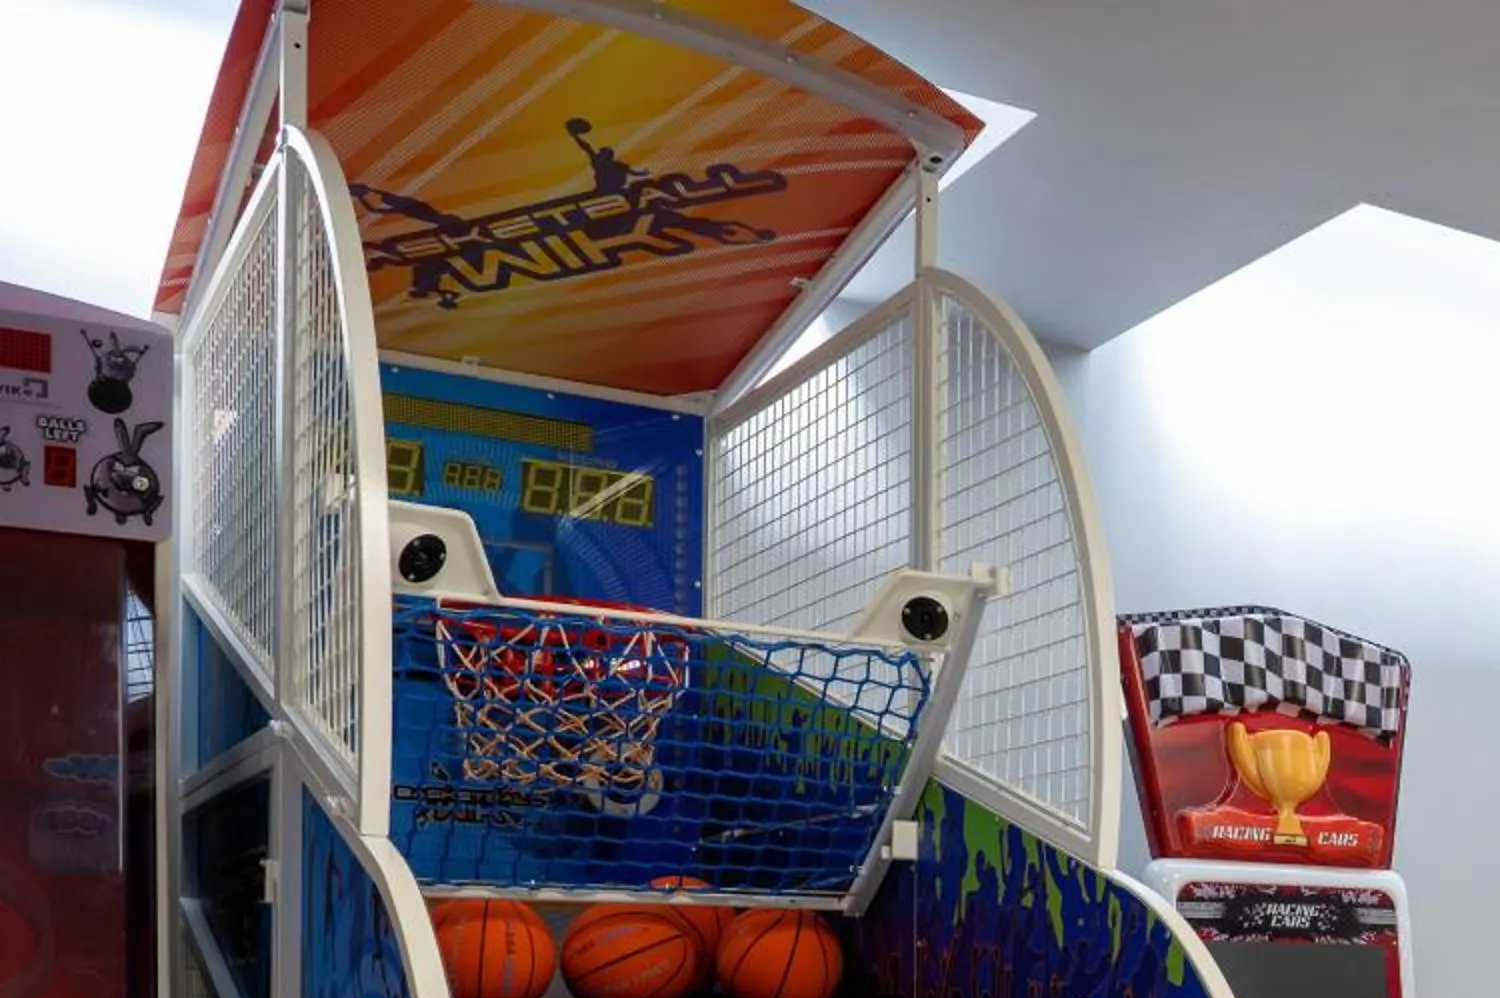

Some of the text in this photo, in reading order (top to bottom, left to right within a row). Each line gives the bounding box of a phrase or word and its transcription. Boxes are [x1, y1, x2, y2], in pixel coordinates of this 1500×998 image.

[366, 170, 777, 263] ASKETBALL
[440, 214, 686, 289] WIK
[45, 427, 79, 442] LEFT
[1212, 825, 1359, 847] RACING CARS
[1265, 903, 1321, 917] RACING
[1270, 915, 1312, 928] CARS
